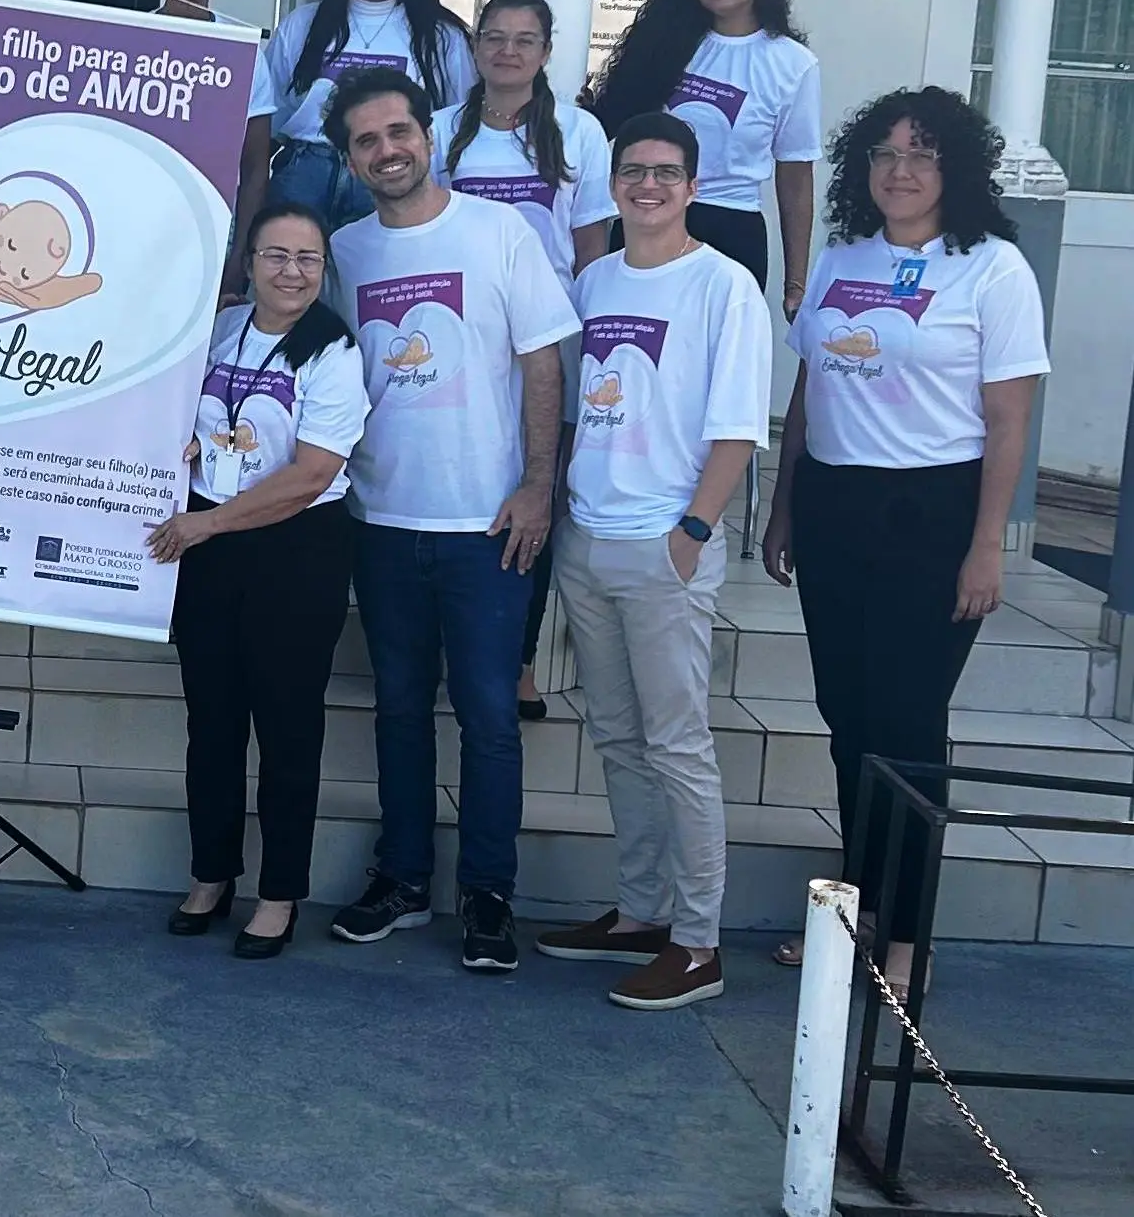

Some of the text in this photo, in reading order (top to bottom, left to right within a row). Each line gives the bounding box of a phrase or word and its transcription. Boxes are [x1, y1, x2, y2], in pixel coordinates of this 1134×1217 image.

[2, 28, 62, 63] filho
[67, 45, 127, 74] para
[134, 51, 232, 89] adoção
[26, 61, 69, 104] de
[78, 71, 194, 122] AMOR
[411, 368, 438, 387] Legal
[822, 357, 884, 380] Entrega Legal
[16, 449, 34, 461] em
[36, 452, 83, 469] entregar
[86, 459, 106, 471] seu
[108, 459, 149, 479] filho(a)
[151, 467, 176, 481] para
[3, 466, 27, 479] será
[29, 470, 105, 490] encaminhada
[106, 479, 114, 491] à
[116, 480, 158, 499] Justiça
[159, 486, 174, 500] da
[25, 491, 53, 503] caso
[54, 491, 75, 505] não
[76, 496, 131, 514] configura
[131, 504, 166, 519] crime.
[63, 553, 142, 572] MATO GROSSO
[64, 543, 143, 561] PODER JUDICIÁRIO
